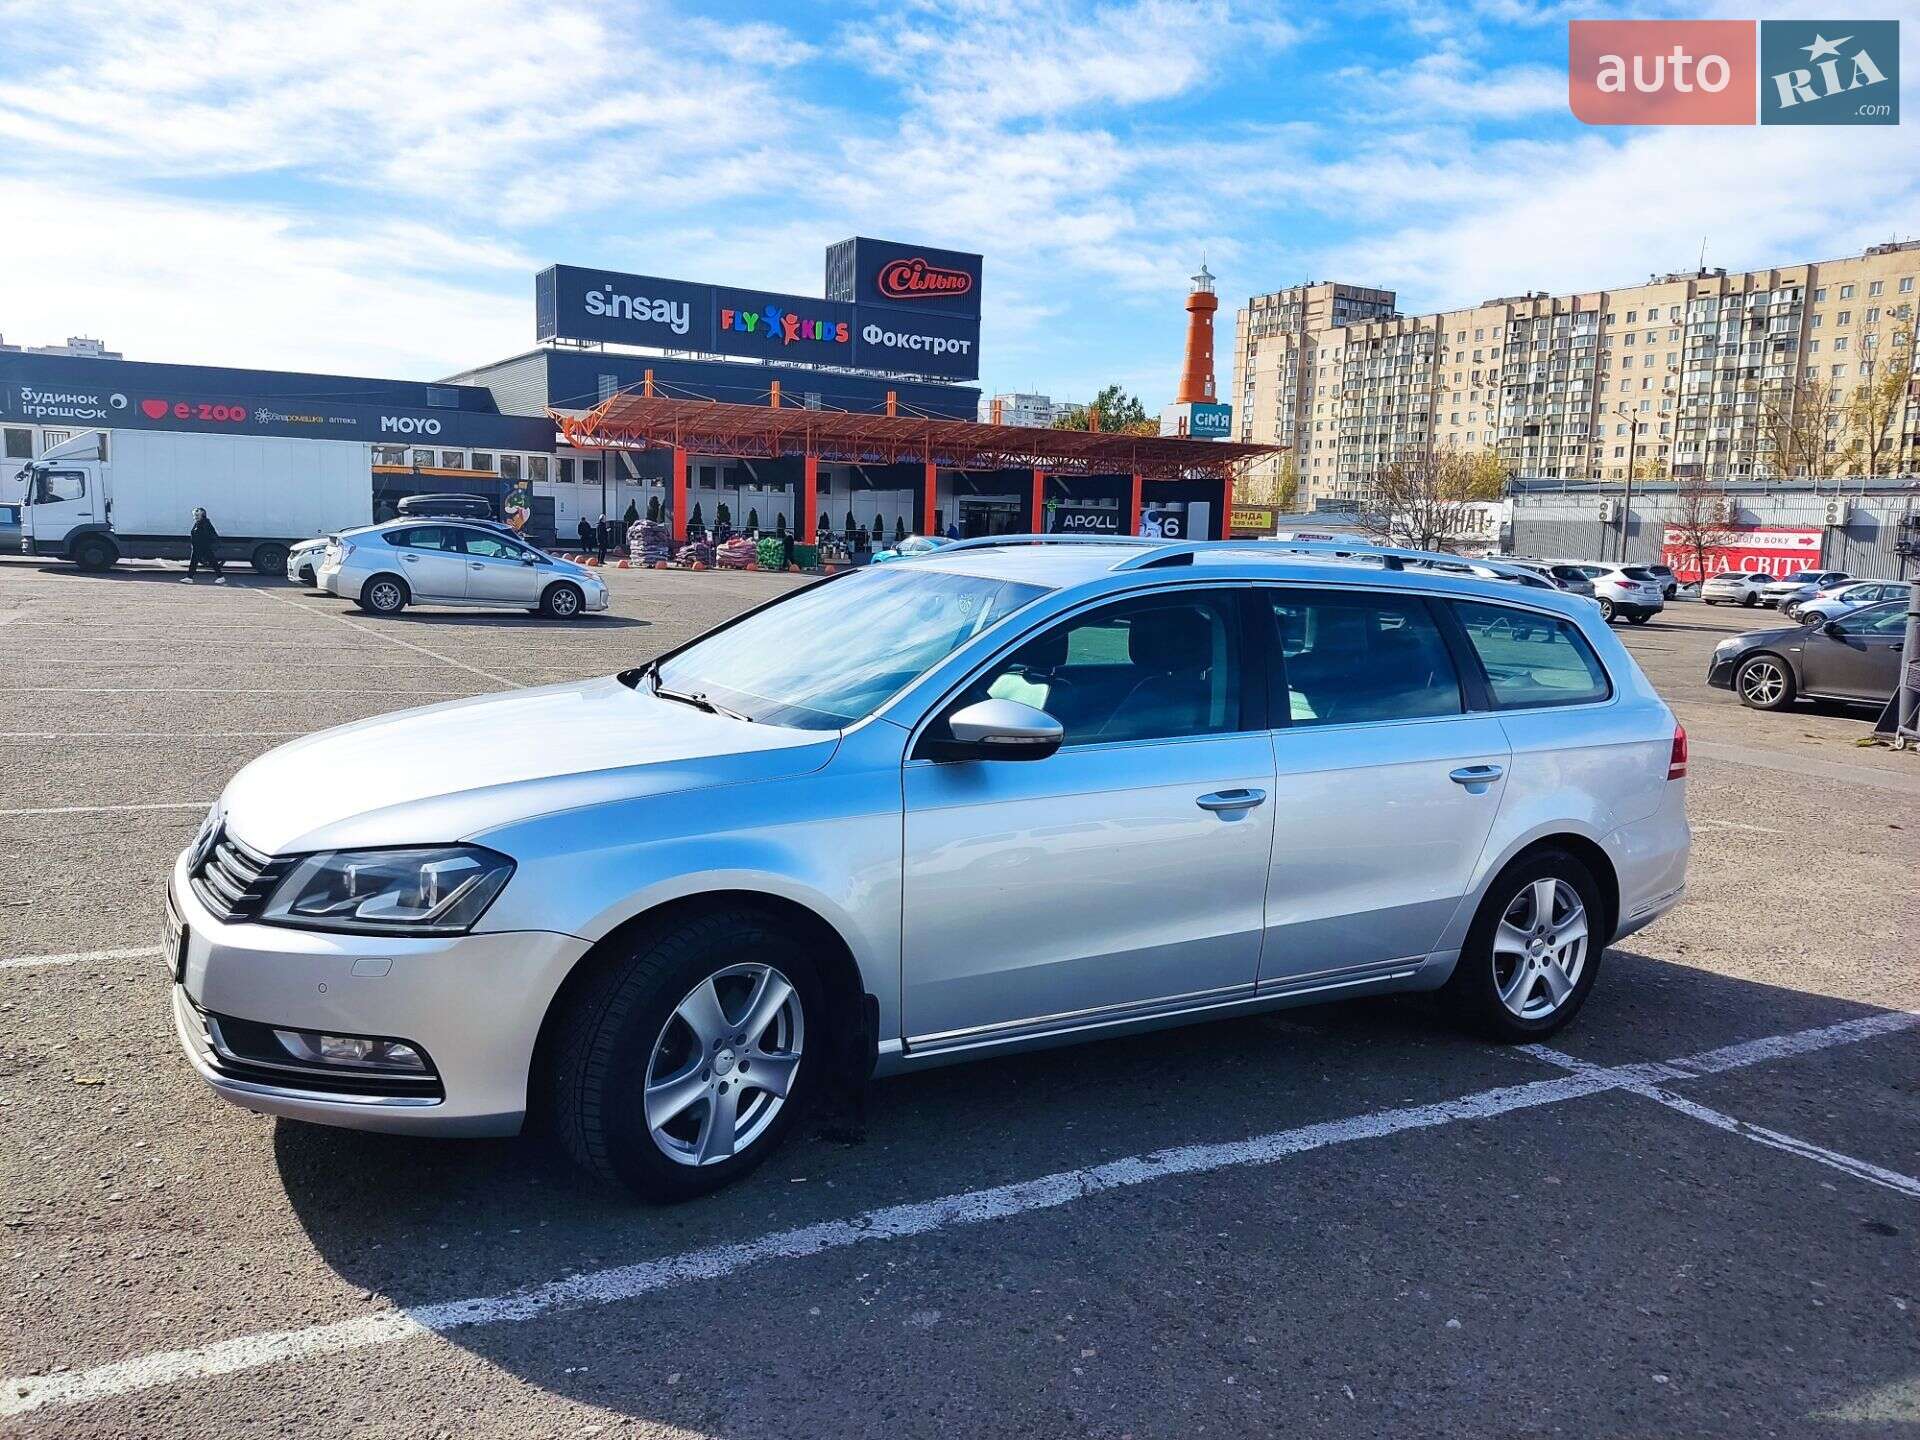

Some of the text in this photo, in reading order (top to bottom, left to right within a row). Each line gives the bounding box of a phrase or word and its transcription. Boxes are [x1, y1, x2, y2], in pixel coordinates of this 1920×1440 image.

[889, 264, 966, 291] Сільпо
[585, 284, 690, 335] sinsay
[721, 309, 849, 343] FLY KIDS
[862, 324, 971, 355] Фокстрот
[21, 387, 98, 404] будинок
[22, 402, 107, 418] іграшок
[174, 402, 247, 421] e-zoo
[380, 416, 441, 435] MOYO
[1229, 511, 1263, 520] РЕНДА
[1740, 555, 1815, 577] СВІТУ
